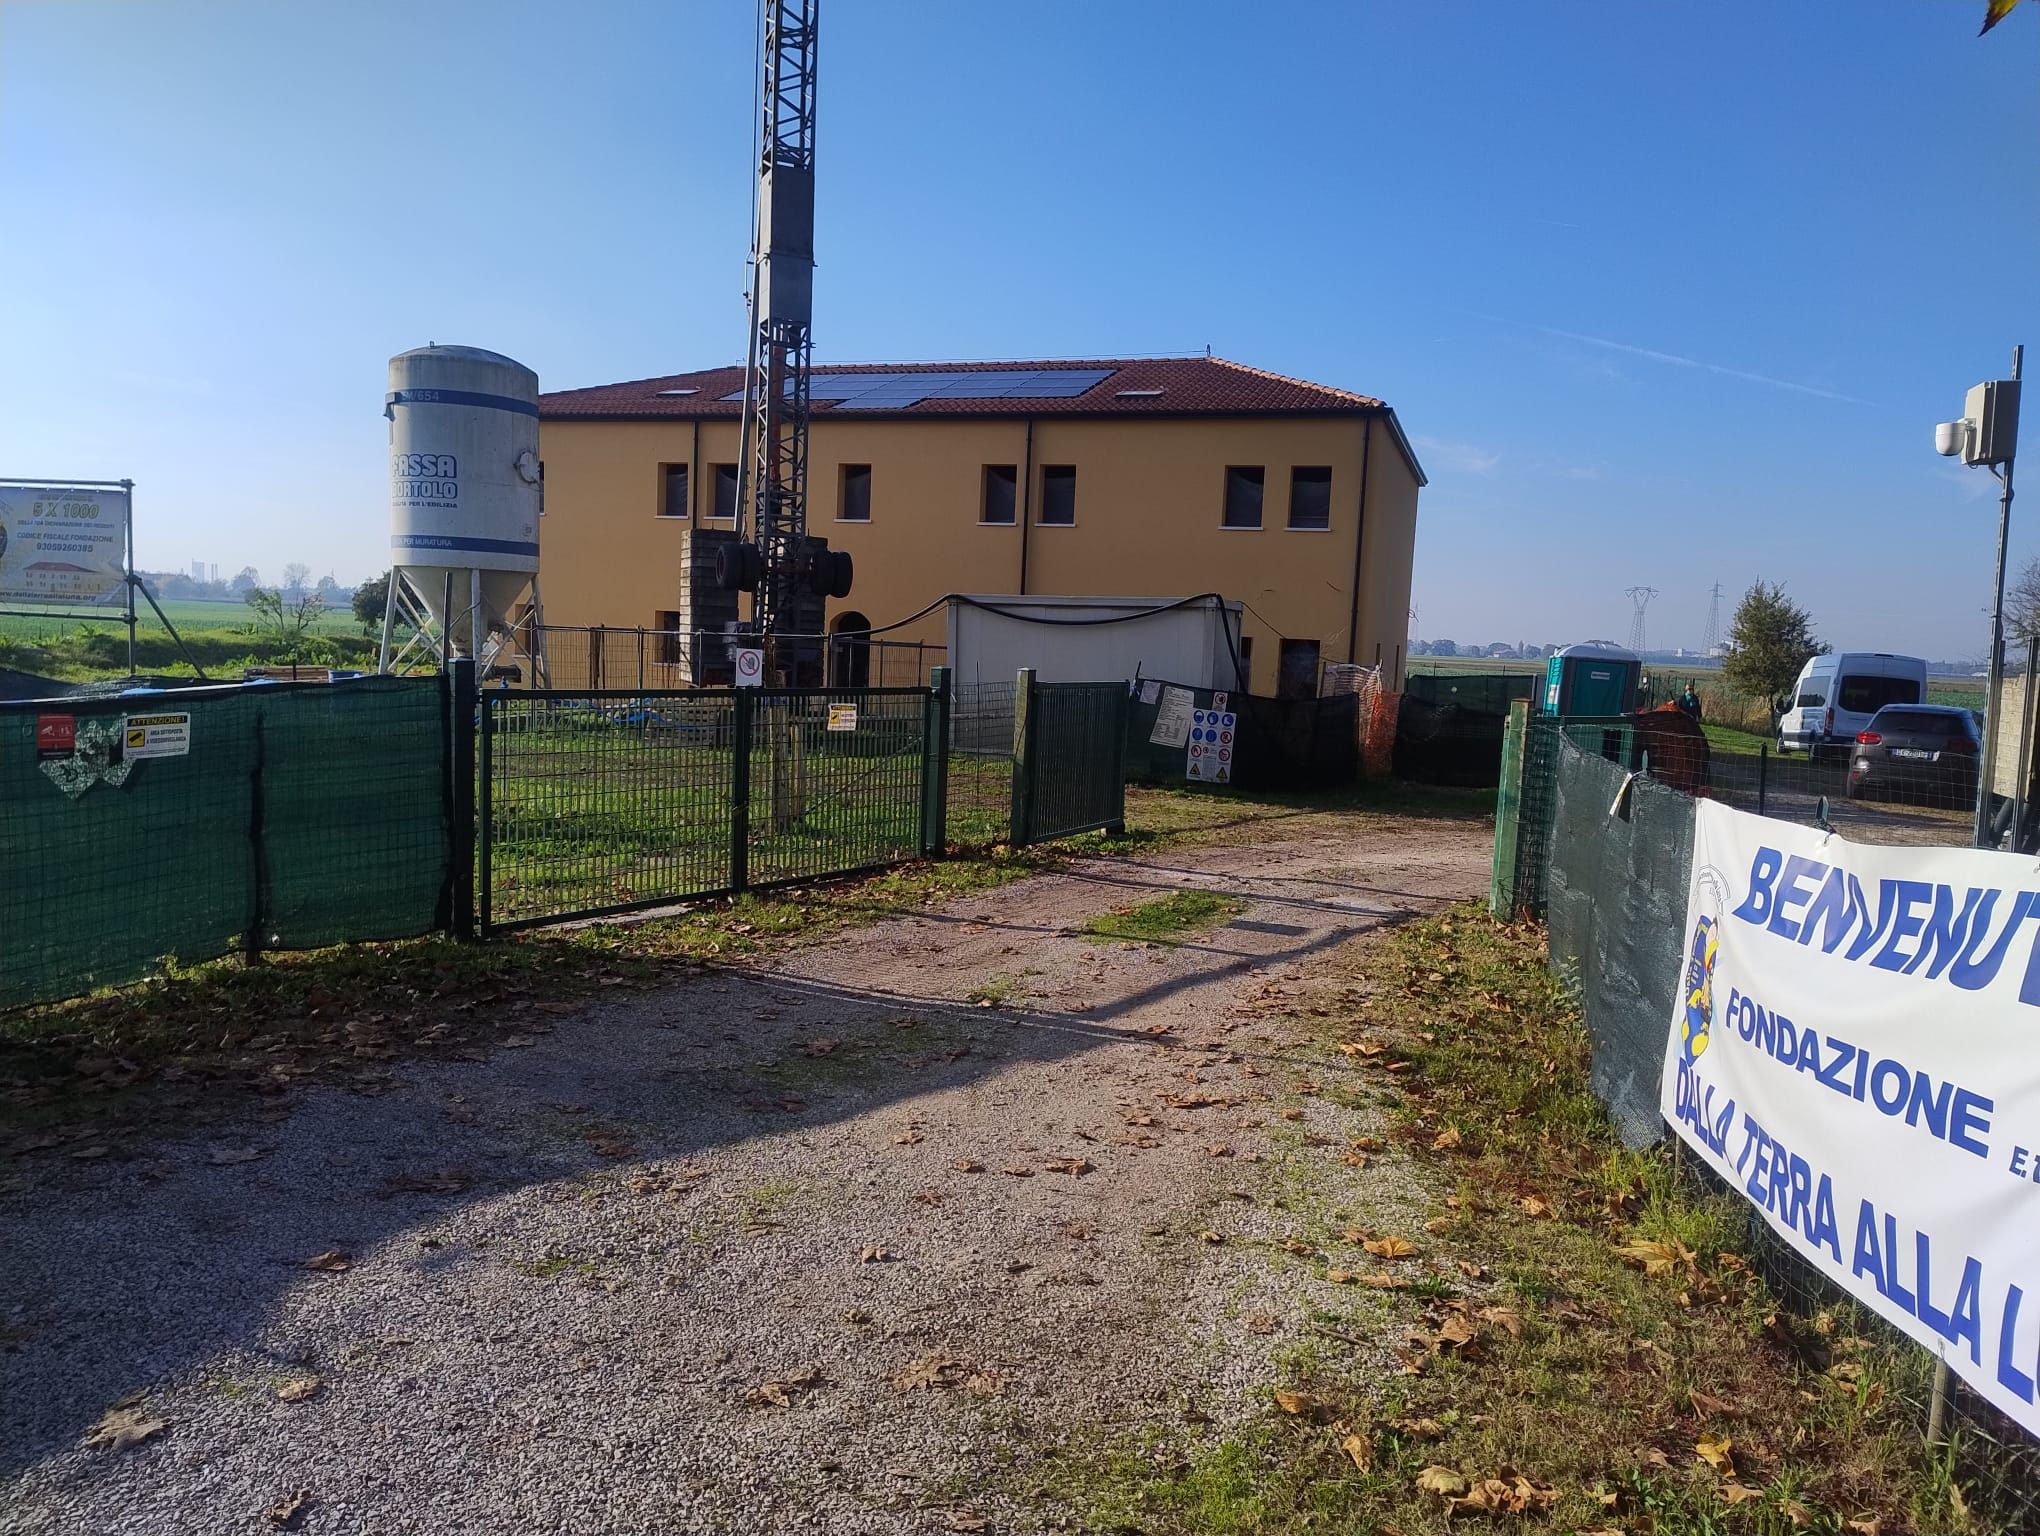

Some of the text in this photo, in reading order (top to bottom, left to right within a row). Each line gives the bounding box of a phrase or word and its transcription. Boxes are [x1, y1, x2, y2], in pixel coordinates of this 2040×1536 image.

[392, 454, 457, 478] FASSA
[32, 502, 100, 519] 5 X 1000
[43, 533, 69, 541] FISCALE
[131, 716, 185, 726] ATTENZIONE!
[1726, 987, 1994, 1158] FONDAZIONE
[1674, 1057, 2040, 1406] DALLA TERRA ALLA L
